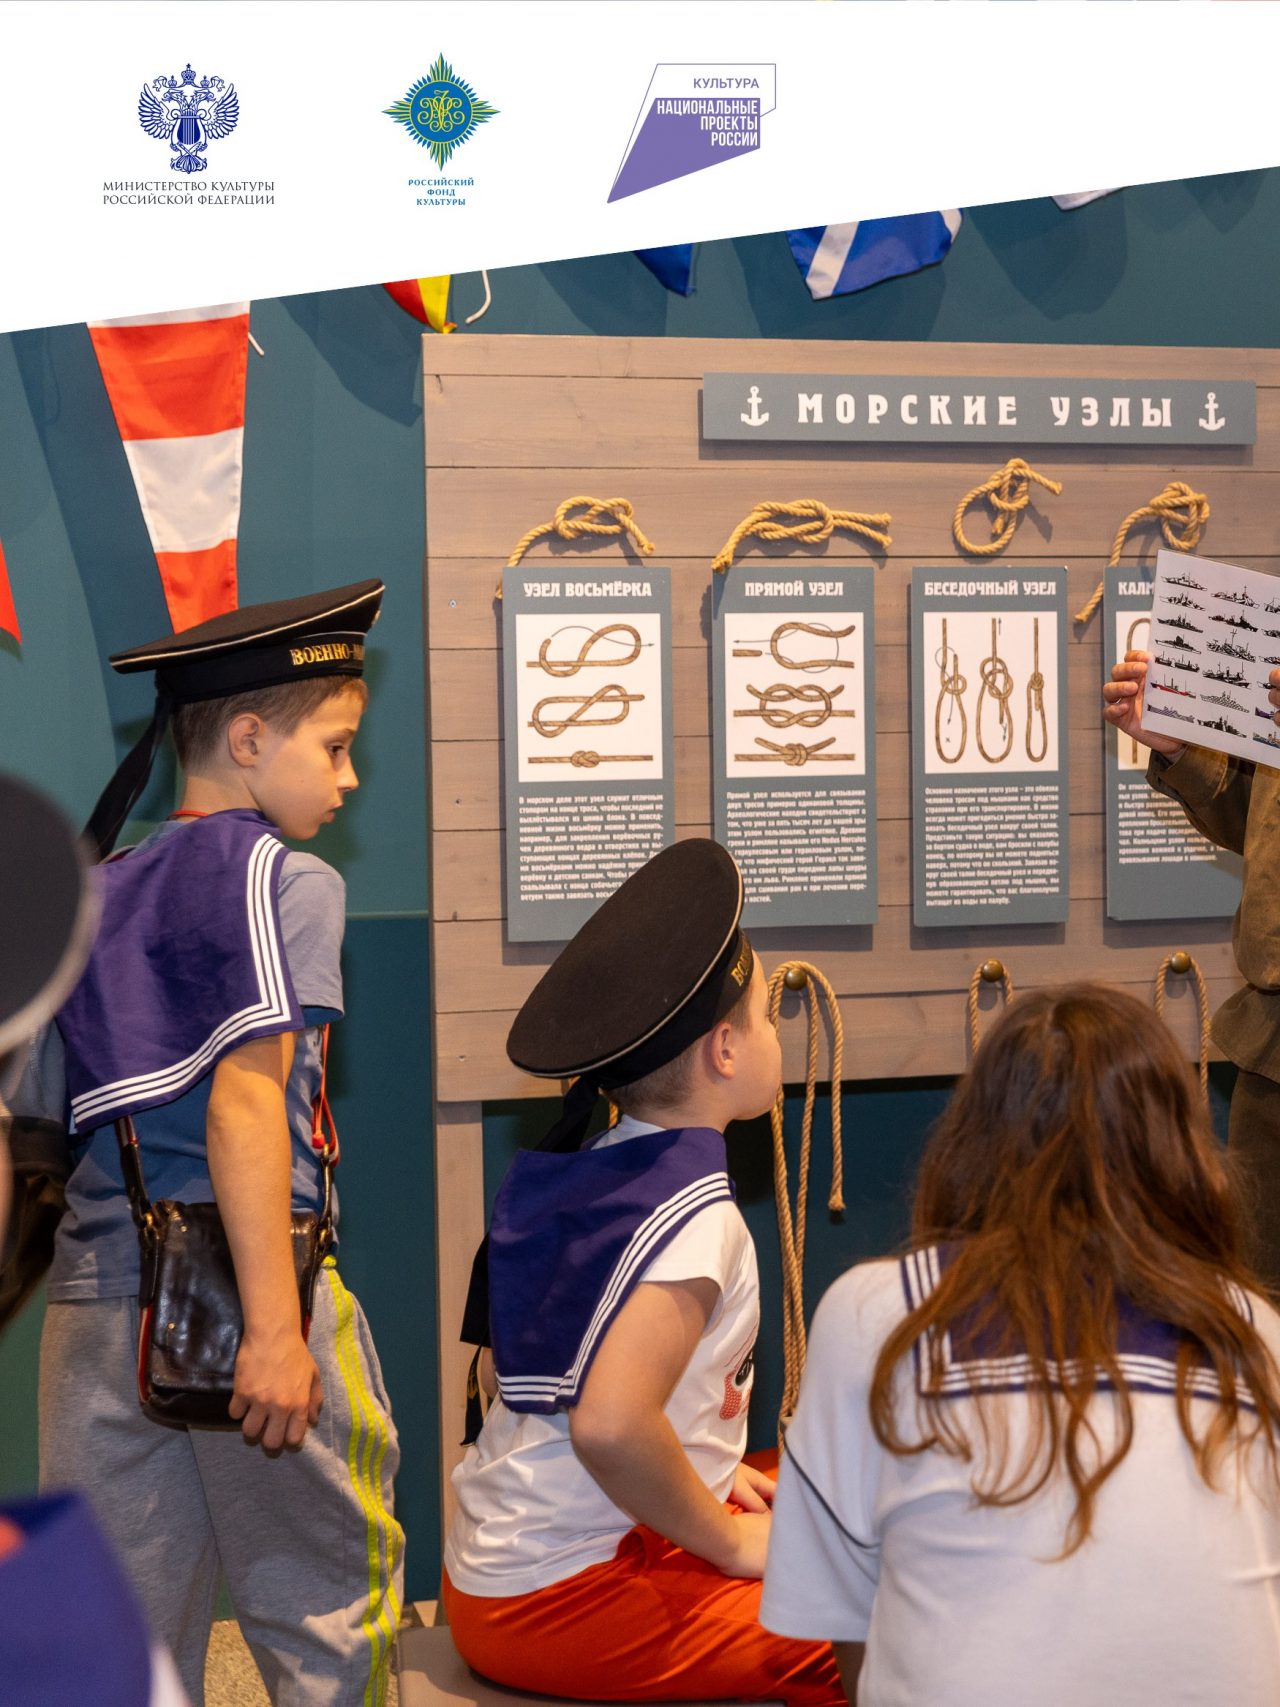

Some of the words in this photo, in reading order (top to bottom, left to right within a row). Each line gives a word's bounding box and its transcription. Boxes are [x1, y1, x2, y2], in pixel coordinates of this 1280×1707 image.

[798, 393, 1016, 425] МОРСКИЕ
[1050, 397, 1171, 426] УЗЛЫ
[524, 583, 560, 597] УЗЕЛ
[566, 581, 651, 596] ВОСЬМЁРКА
[745, 581, 803, 596] ПРЯМОЙ
[809, 582, 843, 595] УЗЕЛ
[925, 580, 1018, 596] БЕСЕДОЧНЫЙ
[1023, 582, 1056, 595] УЗЕЛ
